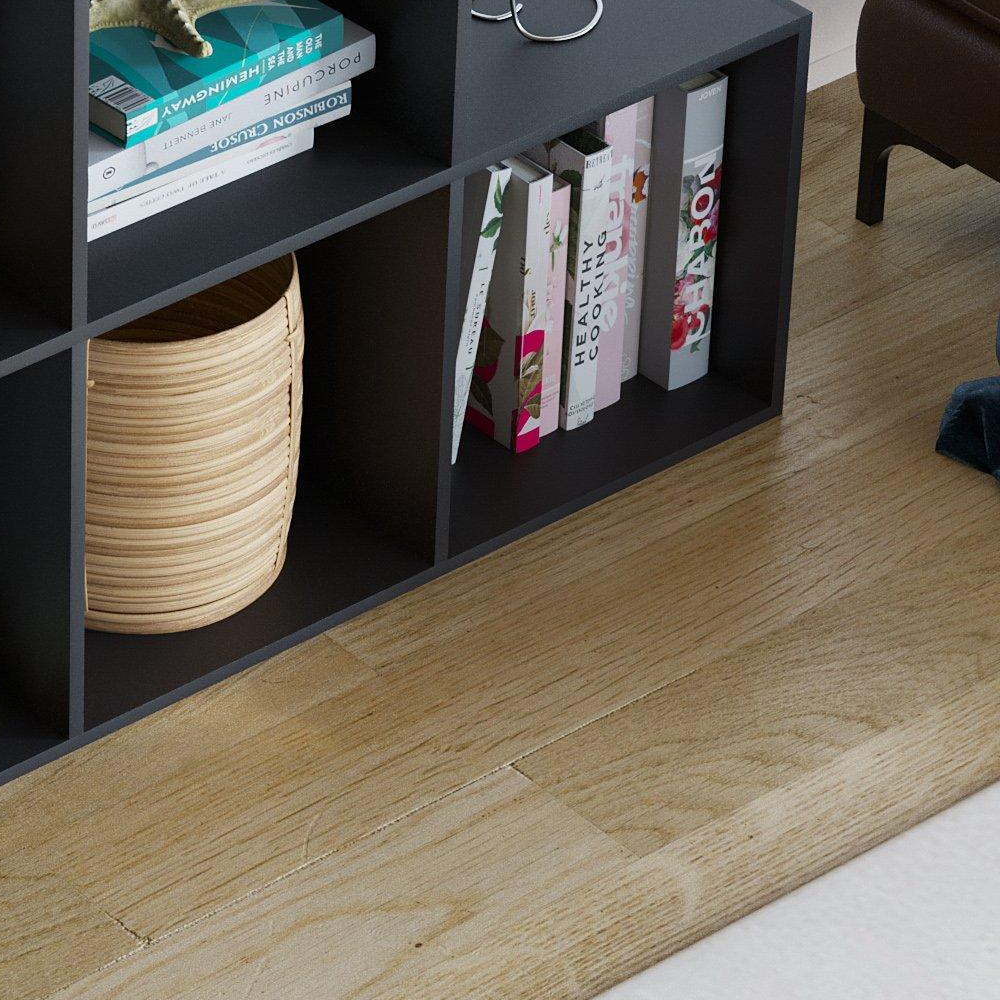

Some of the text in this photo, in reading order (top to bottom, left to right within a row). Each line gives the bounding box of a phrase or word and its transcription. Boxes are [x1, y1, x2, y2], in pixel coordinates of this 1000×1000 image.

[295, 41, 304, 59] MAN
[305, 37, 313, 54] OLD
[313, 33, 323, 50] THE
[267, 55, 276, 72] SEA
[277, 50, 286, 67] THE
[286, 46, 294, 63] AND
[264, 52, 361, 105] PORCUPINE
[162, 64, 260, 117] HEMINGWAY
[698, 85, 722, 101] JOVEN
[208, 112, 233, 127] JANE
[273, 92, 348, 129] ROBINSON
[162, 122, 207, 149] BENNETT
[688, 153, 718, 337] CHABON
[574, 239, 594, 367] HEALTHY
[589, 229, 608, 362] COOKING
